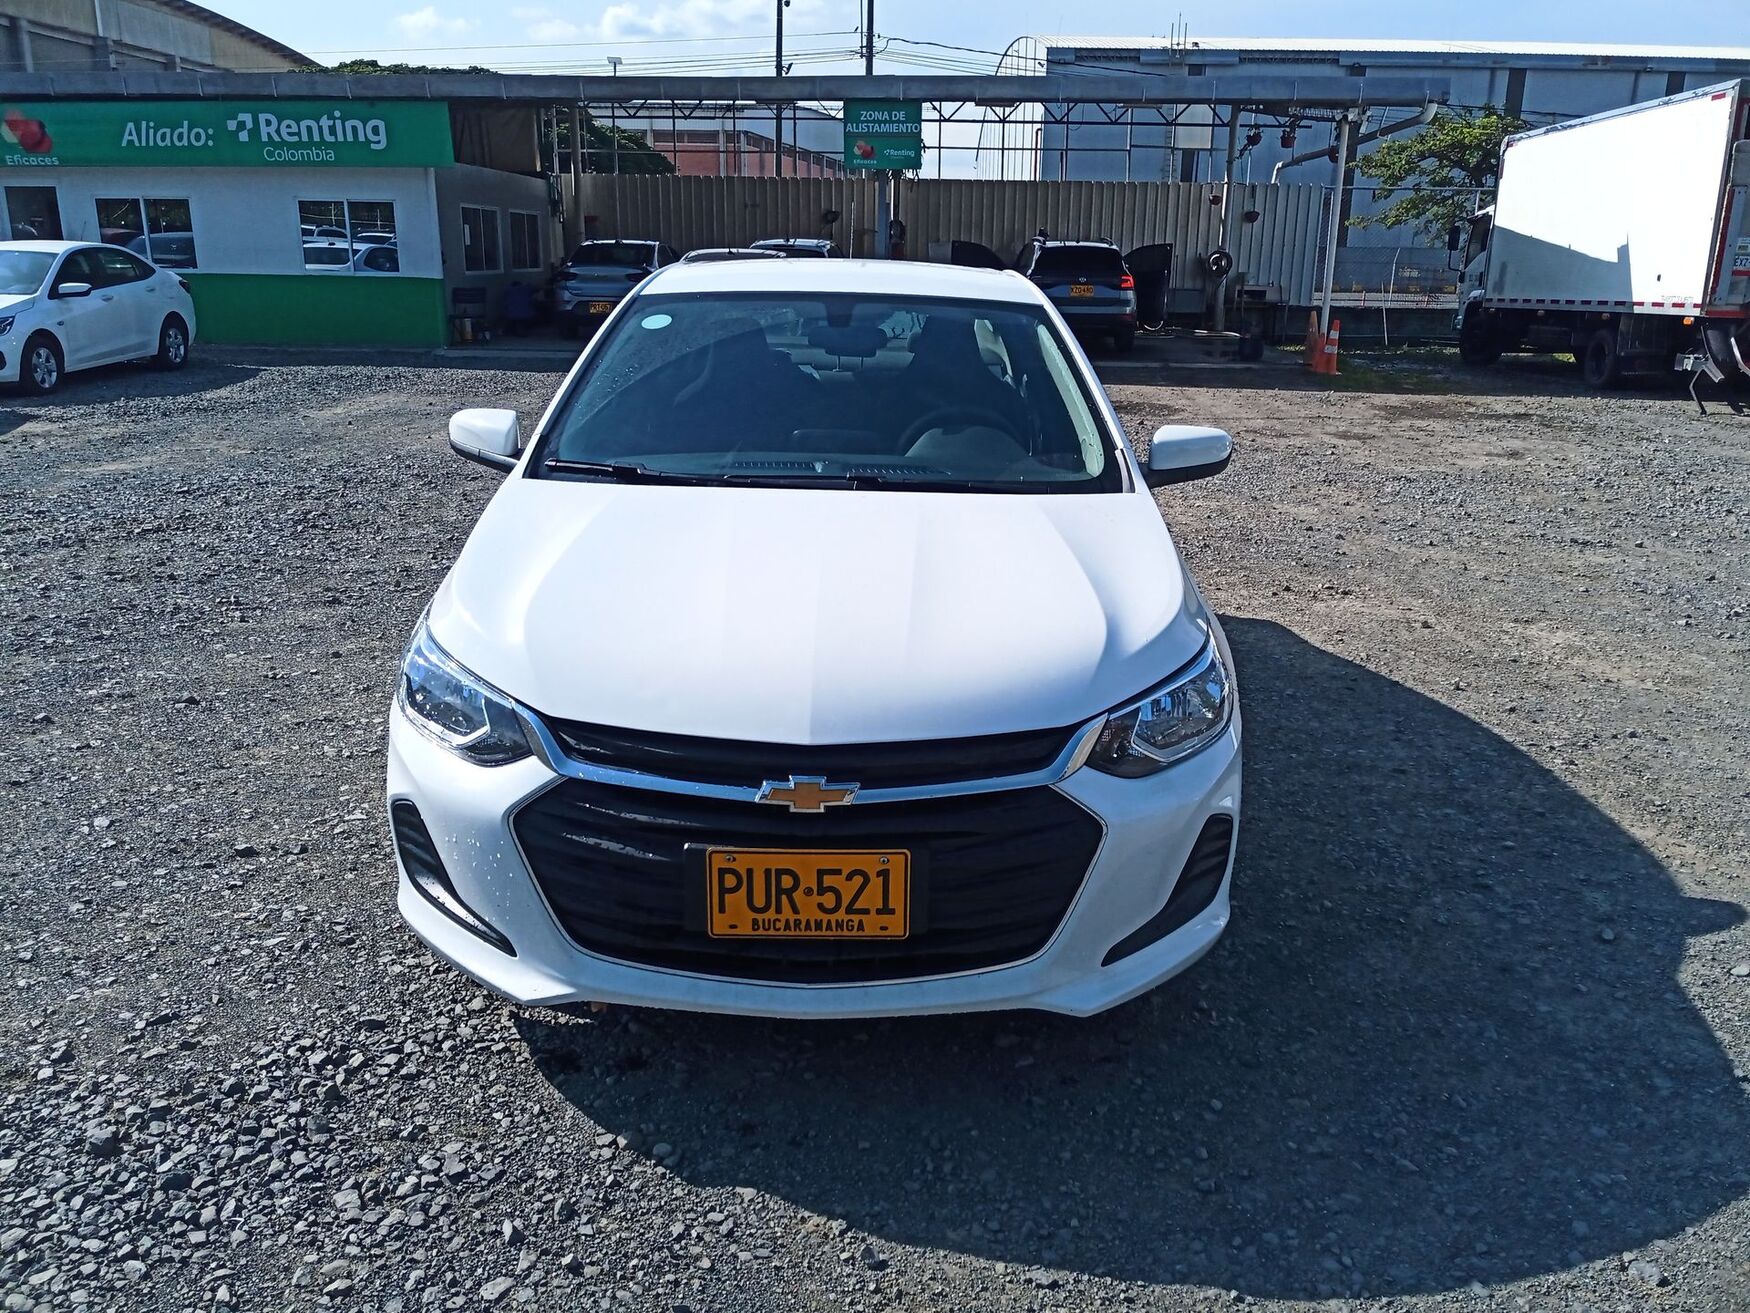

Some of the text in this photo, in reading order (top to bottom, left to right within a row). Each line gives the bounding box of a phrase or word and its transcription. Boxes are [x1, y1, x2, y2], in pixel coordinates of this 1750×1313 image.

[860, 111, 906, 121] ZONA DE
[121, 120, 214, 147] Aliado:
[258, 110, 387, 150] Renting
[846, 123, 920, 133] ALISTAMIENTO
[5, 154, 60, 166] Eficaces
[263, 146, 335, 162] Colombia
[890, 149, 915, 157] Renting
[751, 917, 866, 933] BUCARAMANGA
